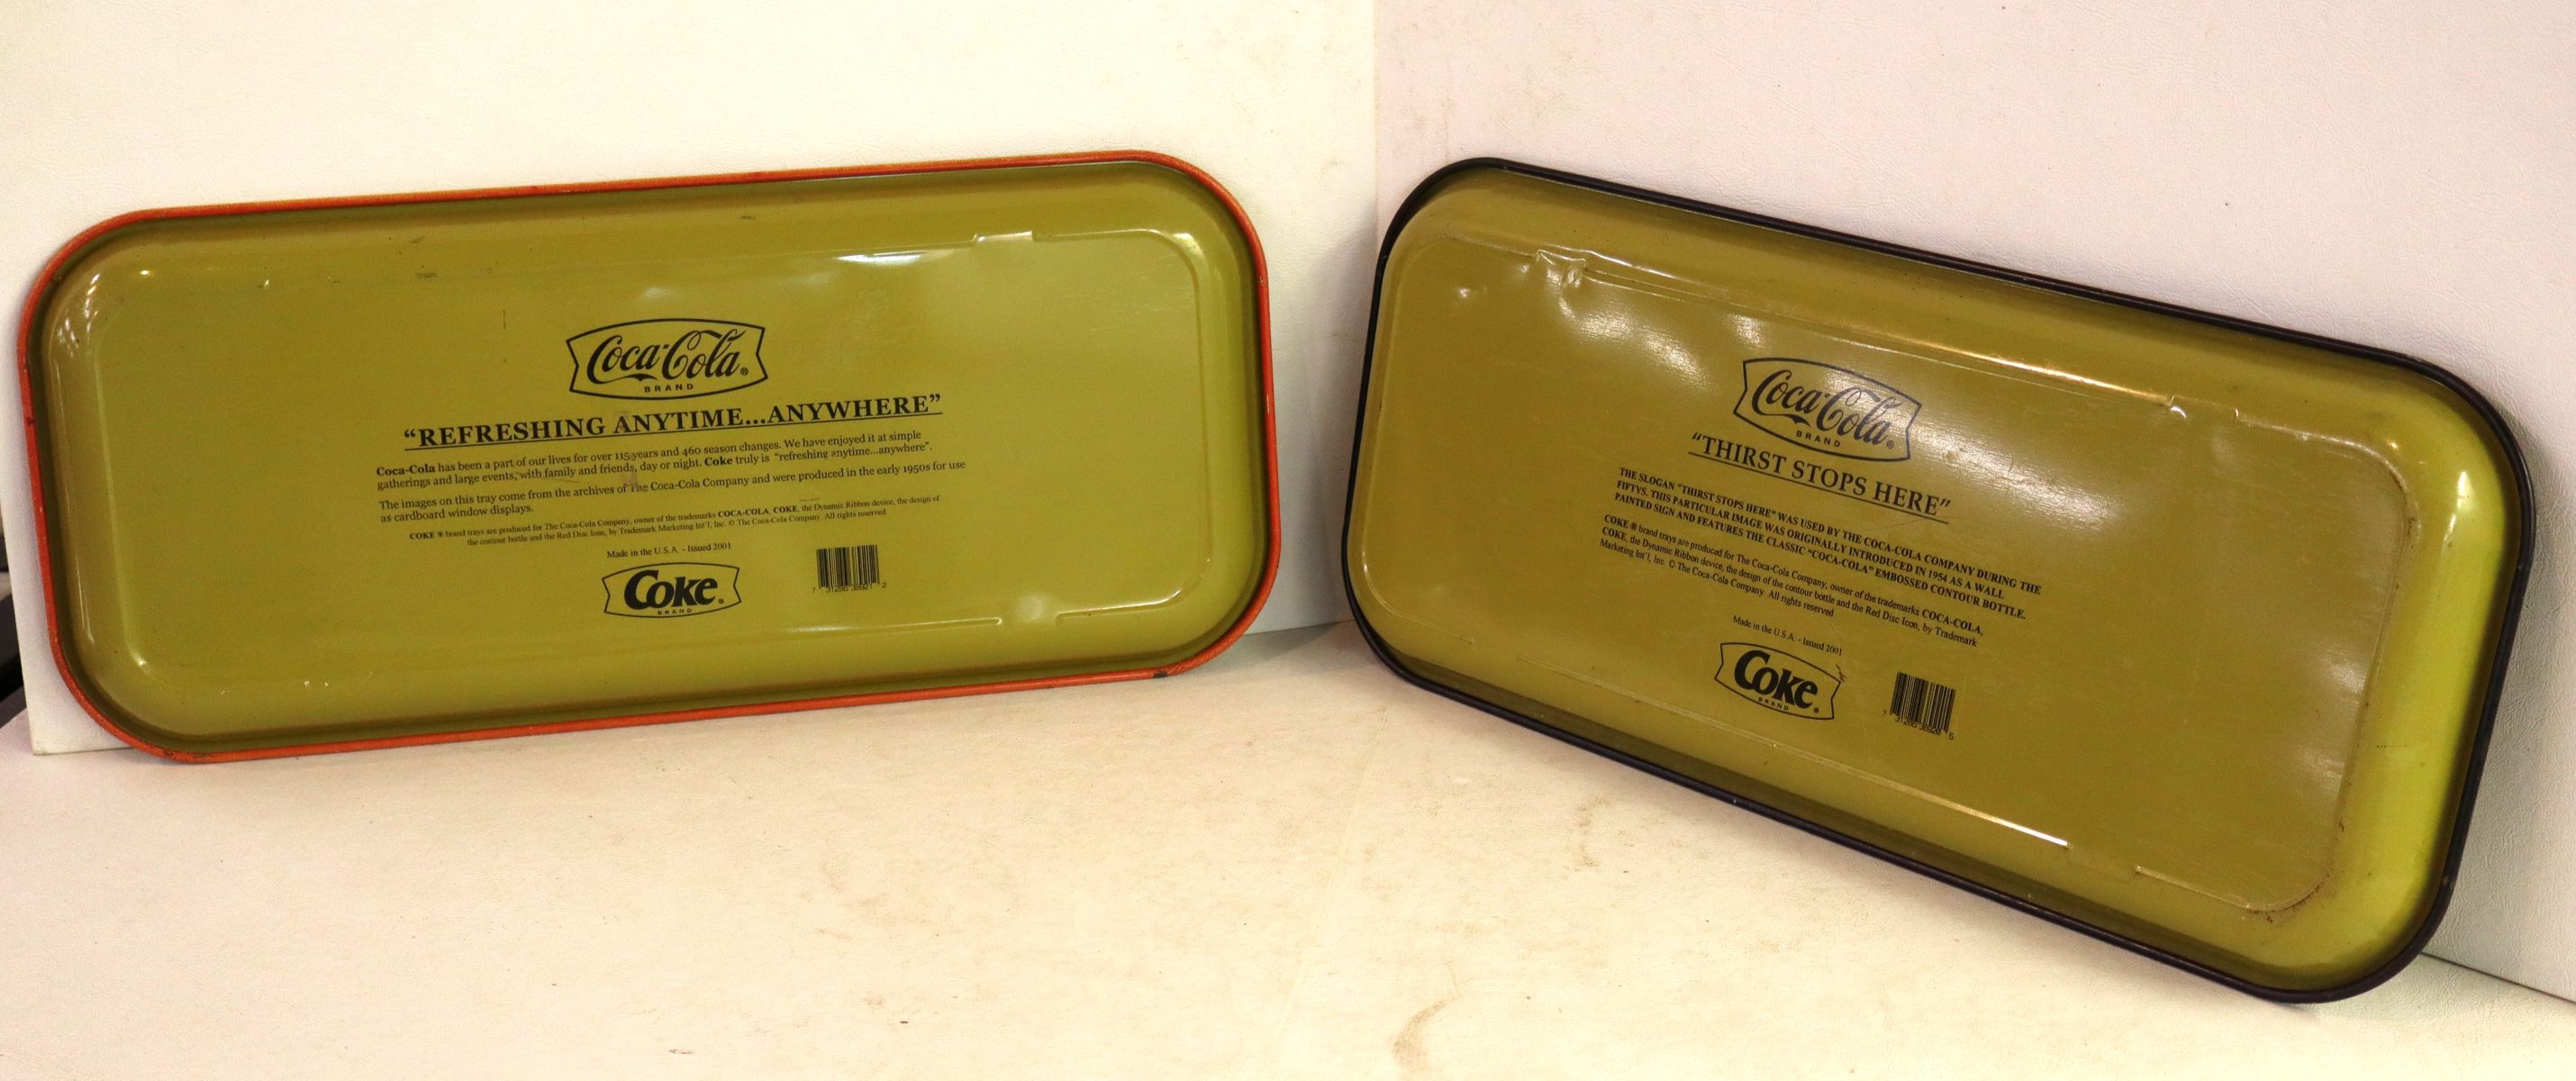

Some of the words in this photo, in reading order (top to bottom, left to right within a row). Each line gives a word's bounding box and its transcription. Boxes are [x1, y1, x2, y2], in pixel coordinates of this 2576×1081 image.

[644, 384, 694, 392] BRAND
[376, 463, 435, 476] Coca-Cola
[437, 462, 456, 472] has
[457, 460, 482, 470] been
[493, 459, 514, 470] part
[528, 458, 546, 466] our
[548, 454, 571, 464] lives
[573, 453, 587, 462] for
[590, 453, 612, 461] over
[630, 450, 658, 460] years
[660, 446, 679, 457] and
[681, 446, 701, 457] 460
[703, 444, 737, 454] season
[739, 441, 781, 451] changes.
[802, 437, 825, 447] have
[827, 433, 866, 447] enjoyed
[888, 429, 921, 442] simple
[404, 416, 605, 446] “REFRESHING
[1796, 430, 1841, 448] BRAND
[376, 477, 431, 491] gatherings
[432, 474, 452, 485] and
[454, 473, 479, 485] large
[481, 471, 518, 482] events,
[518, 468, 541, 478] with
[544, 466, 576, 478] family
[578, 464, 597, 475] and
[599, 461, 637, 473] friends,
[639, 460, 658, 472] day
[673, 458, 702, 470] night.
[703, 455, 732, 467] Coke
[735, 453, 758, 465] truly
[378, 499, 399, 510] The
[401, 498, 437, 509] images
[454, 495, 474, 504] this
[476, 495, 496, 504] tray
[498, 493, 525, 501] come
[528, 489, 552, 499] from
[554, 487, 570, 497] the
[573, 485, 614, 496] archives
[649, 478, 700, 491] Coca-Cola
[702, 477, 749, 487] Company
[751, 473, 770, 484] and
[798, 467, 844, 482] produced
[858, 466, 875, 476] the
[875, 463, 900, 476] early
[903, 464, 930, 474] 1950s
[932, 460, 947, 470] for
[948, 461, 966, 469] use
[1692, 431, 1786, 474] “THIRST
[1791, 459, 1866, 495] STOPS
[1872, 480, 1951, 515] HERE”
[394, 508, 445, 522] cardboard
[448, 506, 487, 517] window
[489, 504, 533, 515] displays.
[1619, 467, 1637, 479] THE
[1637, 473, 1674, 490] SLOGAN
[1715, 495, 1744, 510] STOPS
[1777, 512, 1798, 525] WAS
[1800, 518, 1825, 532] USED
[1842, 530, 1862, 543] THE
[1864, 537, 1921, 560] COCA-COLA
[1924, 554, 1975, 576] COMPANY
[1976, 568, 2017, 587] DURING
[2019, 580, 2041, 595] THE
[606, 550, 628, 558] Made
[687, 543, 712, 552] Issued
[712, 541, 730, 550] 2001
[1603, 513, 1628, 529] COKE
[1637, 523, 1658, 537] brand
[1658, 531, 1676, 543] trays
[1677, 538, 1689, 547] are
[1689, 541, 1722, 557] produced
[1723, 550, 1735, 559] for
[1736, 553, 1750, 565] The
[1751, 558, 1789, 577] Coca-Cola
[1791, 569, 1828, 589] Company,
[1829, 583, 1853, 595] owner
[1864, 592, 1876, 603] the
[1877, 596, 1919, 616] trademarks
[1614, 492, 1652, 509] PAINTED
[1653, 503, 1674, 516] SIGN
[1675, 510, 1695, 522] AND
[1697, 515, 1743, 536] FEATURES
[1746, 530, 1764, 543] THE
[1765, 536, 1805, 554] CLASSIC
[1807, 548, 1873, 573] “COCA-COLA”
[1874, 568, 1927, 590] EMBOSSED
[1929, 584, 1980, 605] CONTOUR
[1982, 598, 2025, 619] BOTTLE.
[1650, 489, 1671, 502] THIS
[1672, 495, 1729, 519] PARTICULAR
[1731, 513, 1762, 529] IMAGE
[1764, 522, 1784, 535] WAS
[1786, 529, 1846, 553] ORIGINALLY
[1848, 546, 1913, 572] INTRODUCED
[1928, 569, 1947, 582] 1954
[1974, 582, 2004, 599] WALL
[1600, 537, 1634, 558] Marketing
[1677, 561, 1690, 573] The
[1692, 566, 1728, 585] Coca-Cola
[1767, 589, 1780, 600] All
[1780, 595, 1801, 607] rights
[1802, 602, 1834, 617] reserved
[1629, 534, 1640, 545] the
[1642, 538, 1672, 555] Dynamic
[1673, 548, 1699, 563] Ribbon
[1700, 557, 1724, 572] device,
[1726, 564, 1737, 575] the
[1738, 568, 1761, 582] design
[1772, 577, 1783, 588] the
[1784, 584, 1812, 596] contour
[1814, 589, 1835, 604] bottle
[1836, 599, 1850, 608] and
[1851, 602, 1864, 613] the
[1864, 604, 1881, 618] Red
[1882, 610, 1900, 623] Disc
[1901, 616, 1919, 631] Icon,
[1935, 625, 1977, 647] Trademark
[1732, 614, 1751, 628] Made
[1761, 623, 1772, 633] the
[1802, 636, 1824, 650] Issued
[1825, 644, 1842, 656] 2001
[1758, 696, 1789, 711] BRAND
